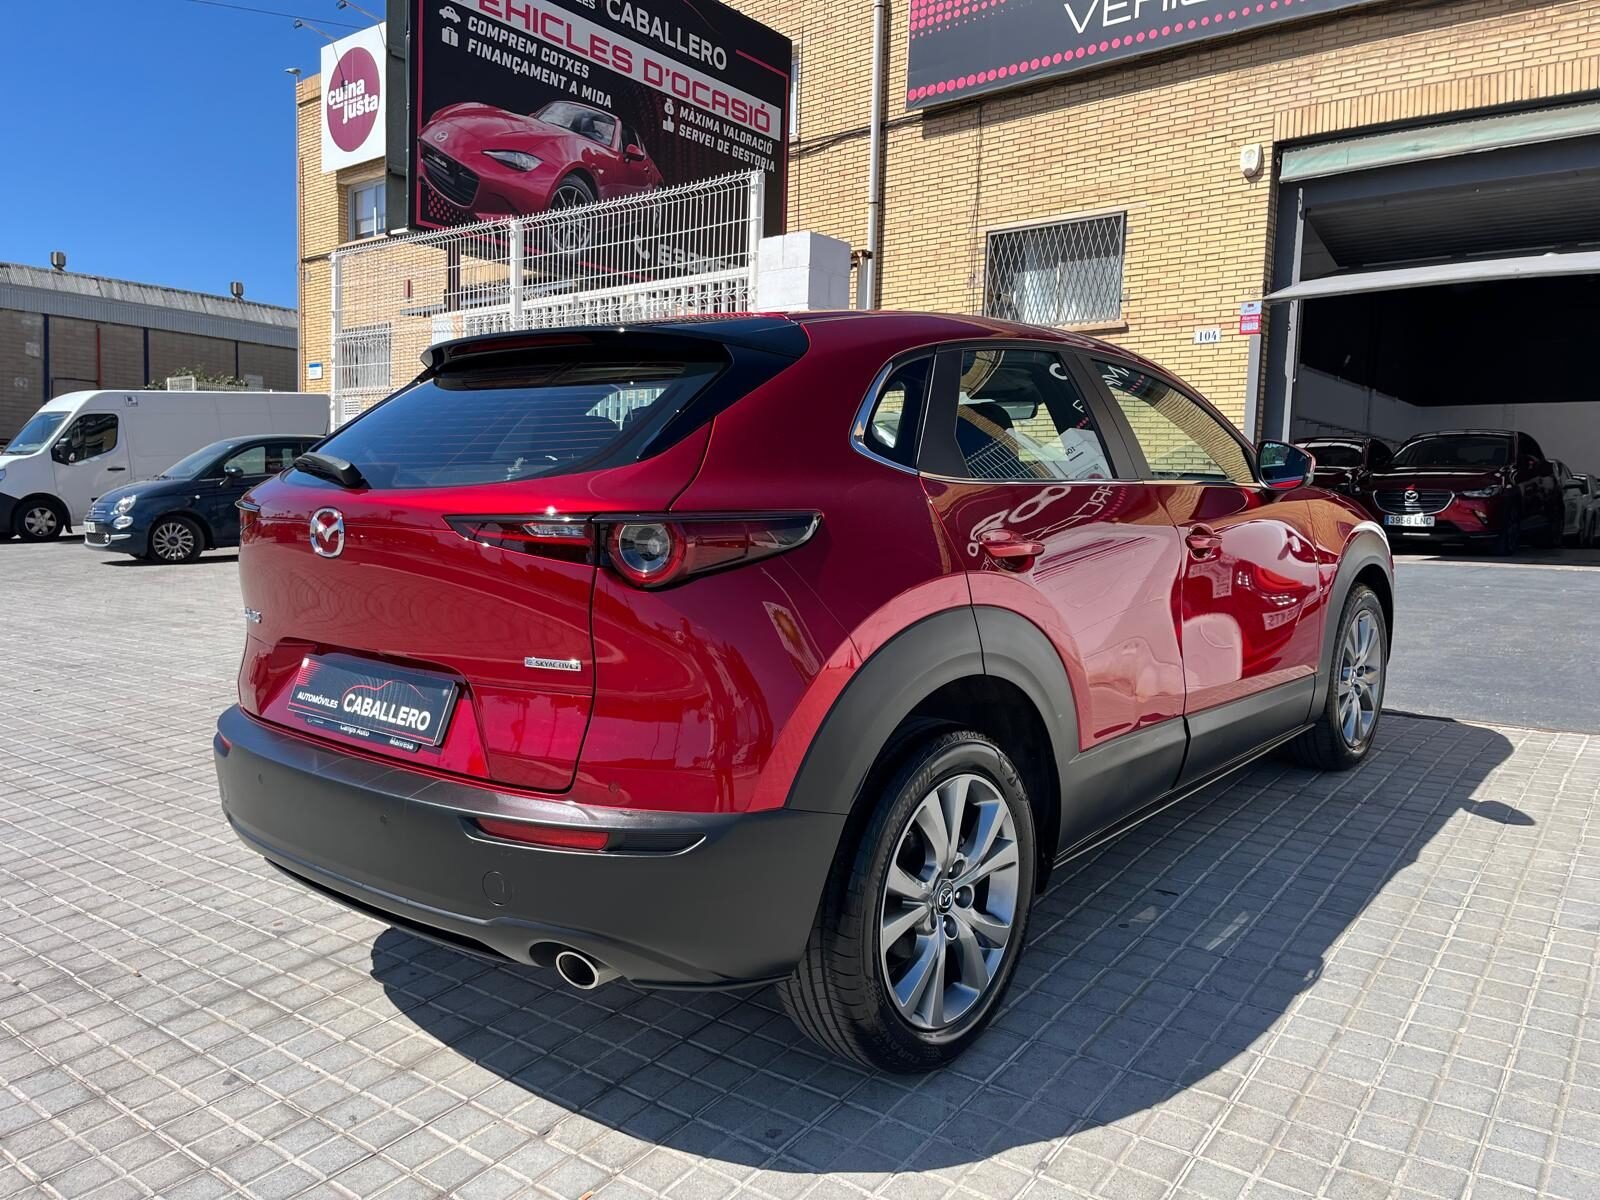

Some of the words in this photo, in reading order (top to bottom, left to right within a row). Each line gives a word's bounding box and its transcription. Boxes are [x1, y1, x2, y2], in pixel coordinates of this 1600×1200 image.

[467, 15, 538, 58] COMPREM
[540, 47, 590, 79] COTXES
[606, 0, 727, 71] CABALLERO
[467, 38, 568, 91] FINANÇAMENT
[568, 80, 578, 95] A
[581, 84, 612, 109] MIDA
[479, 0, 633, 74] EHICLES
[643, 58, 770, 133] D'OCASIÓ
[328, 78, 365, 106] cuina
[342, 93, 379, 125] justa
[678, 124, 715, 149] SERVEI
[717, 139, 730, 155] DE
[732, 144, 775, 173] GESTORIA
[723, 123, 773, 155] VALORACIÓ
[1199, 330, 1217, 342] 104
[1414, 517, 1432, 525] LNC
[296, 691, 339, 709] AUTOMÓVILES
[343, 693, 431, 731] CABALLERO
